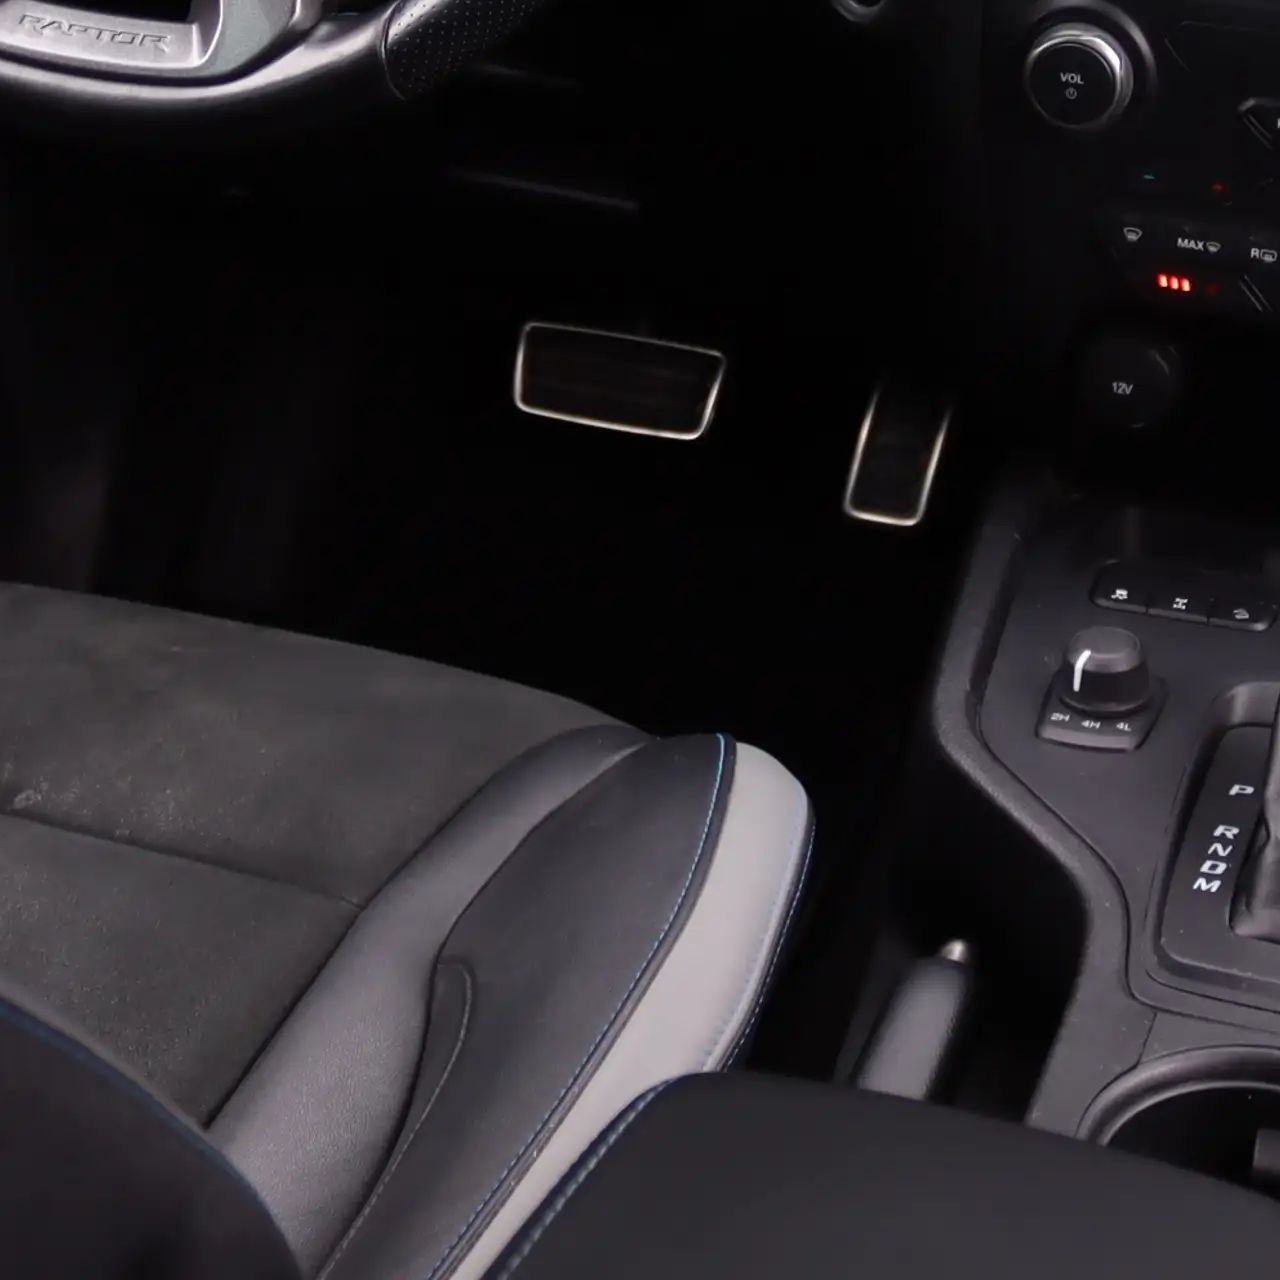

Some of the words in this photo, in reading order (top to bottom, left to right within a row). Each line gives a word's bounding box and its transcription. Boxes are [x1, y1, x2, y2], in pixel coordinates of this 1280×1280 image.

[19, 13, 170, 53] RAPTOR
[1059, 72, 1085, 85] VOL
[1176, 237, 1204, 251] MAX
[1250, 247, 1259, 259] R
[1111, 380, 1134, 396] 12V
[1050, 712, 1070, 723] 2H
[1081, 719, 1101, 730] 4H
[1116, 721, 1132, 732] 4L
[1229, 784, 1255, 798] P
[1213, 824, 1240, 840] R
[1207, 843, 1234, 857] N
[1199, 860, 1227, 875] D
[1192, 877, 1222, 894] M
